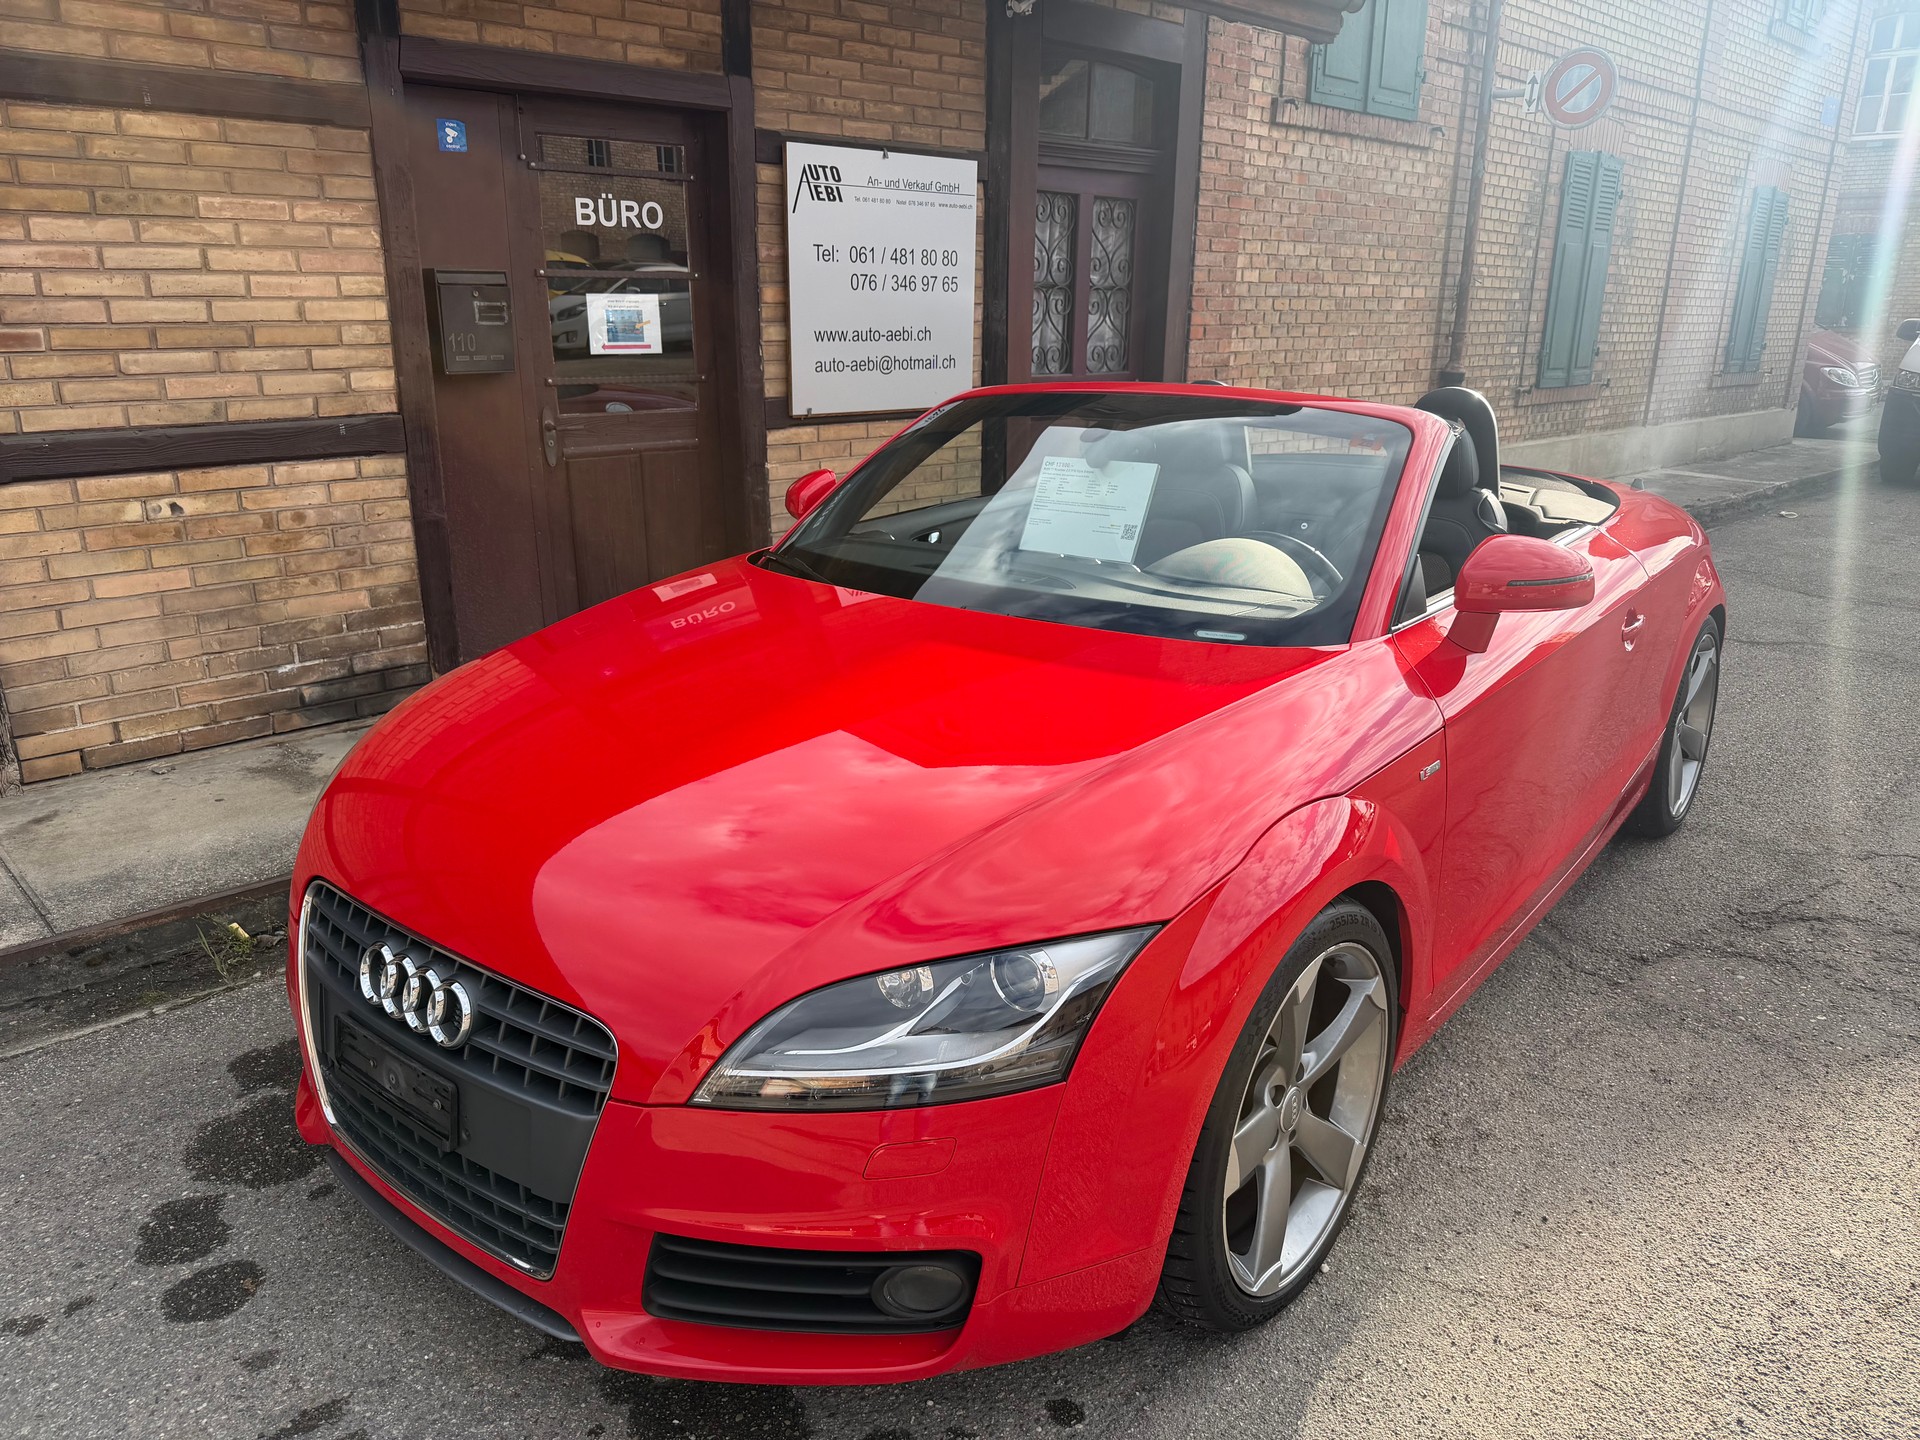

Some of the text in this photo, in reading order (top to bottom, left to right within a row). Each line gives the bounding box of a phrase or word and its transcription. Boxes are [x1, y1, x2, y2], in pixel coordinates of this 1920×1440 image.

[866, 176, 960, 193] An- und Verkauf GmbH
[574, 193, 664, 230] BÜRO
[813, 243, 958, 267] Tel: 061 / 481 80 80
[850, 273, 959, 293] 076 / 346 97 65
[448, 332, 476, 352] 110
[813, 326, 932, 342] www.auto-aebi.ch
[814, 354, 956, 375] auto-aebi@hotmail.ch
[1330, 914, 1359, 931] 255/35
